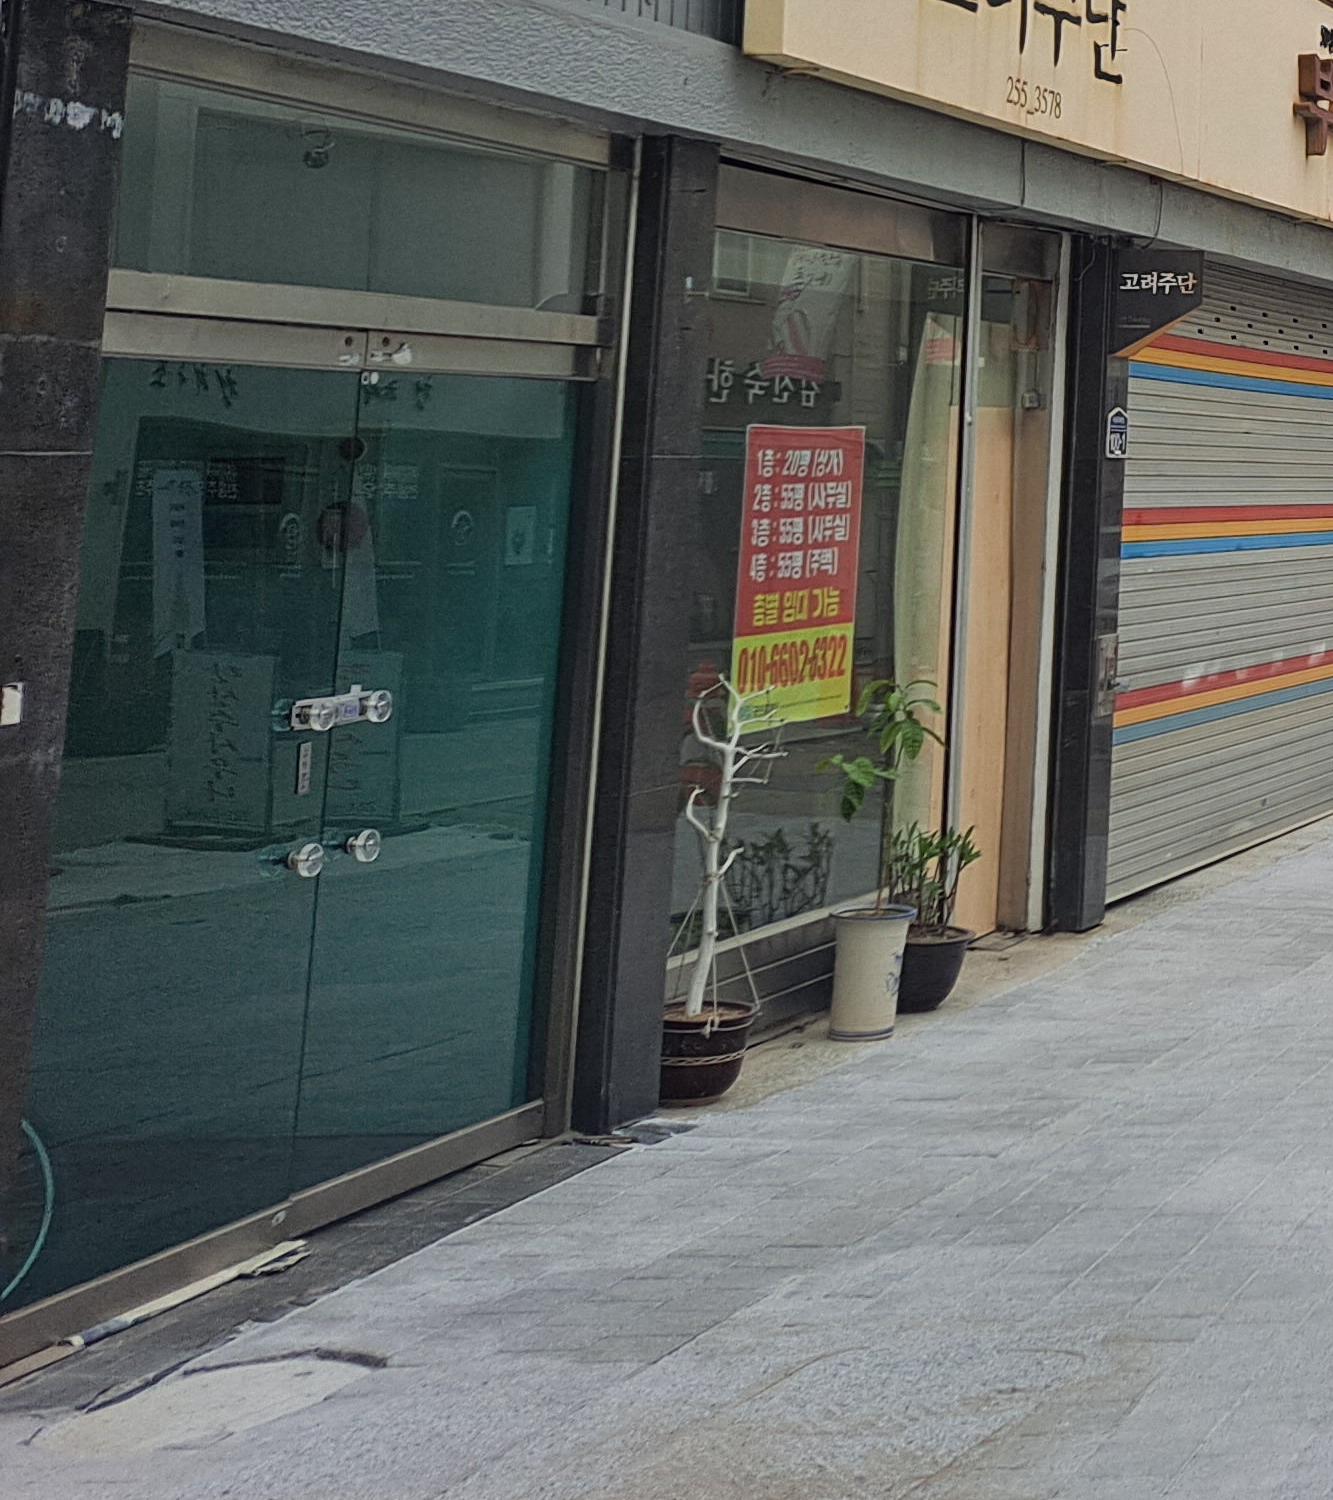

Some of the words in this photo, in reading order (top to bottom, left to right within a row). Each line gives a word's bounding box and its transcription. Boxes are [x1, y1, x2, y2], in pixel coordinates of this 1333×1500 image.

[1119, 271, 1197, 295] 고려주단
[782, 590, 809, 622] 임대
[812, 587, 841, 618] 가능
